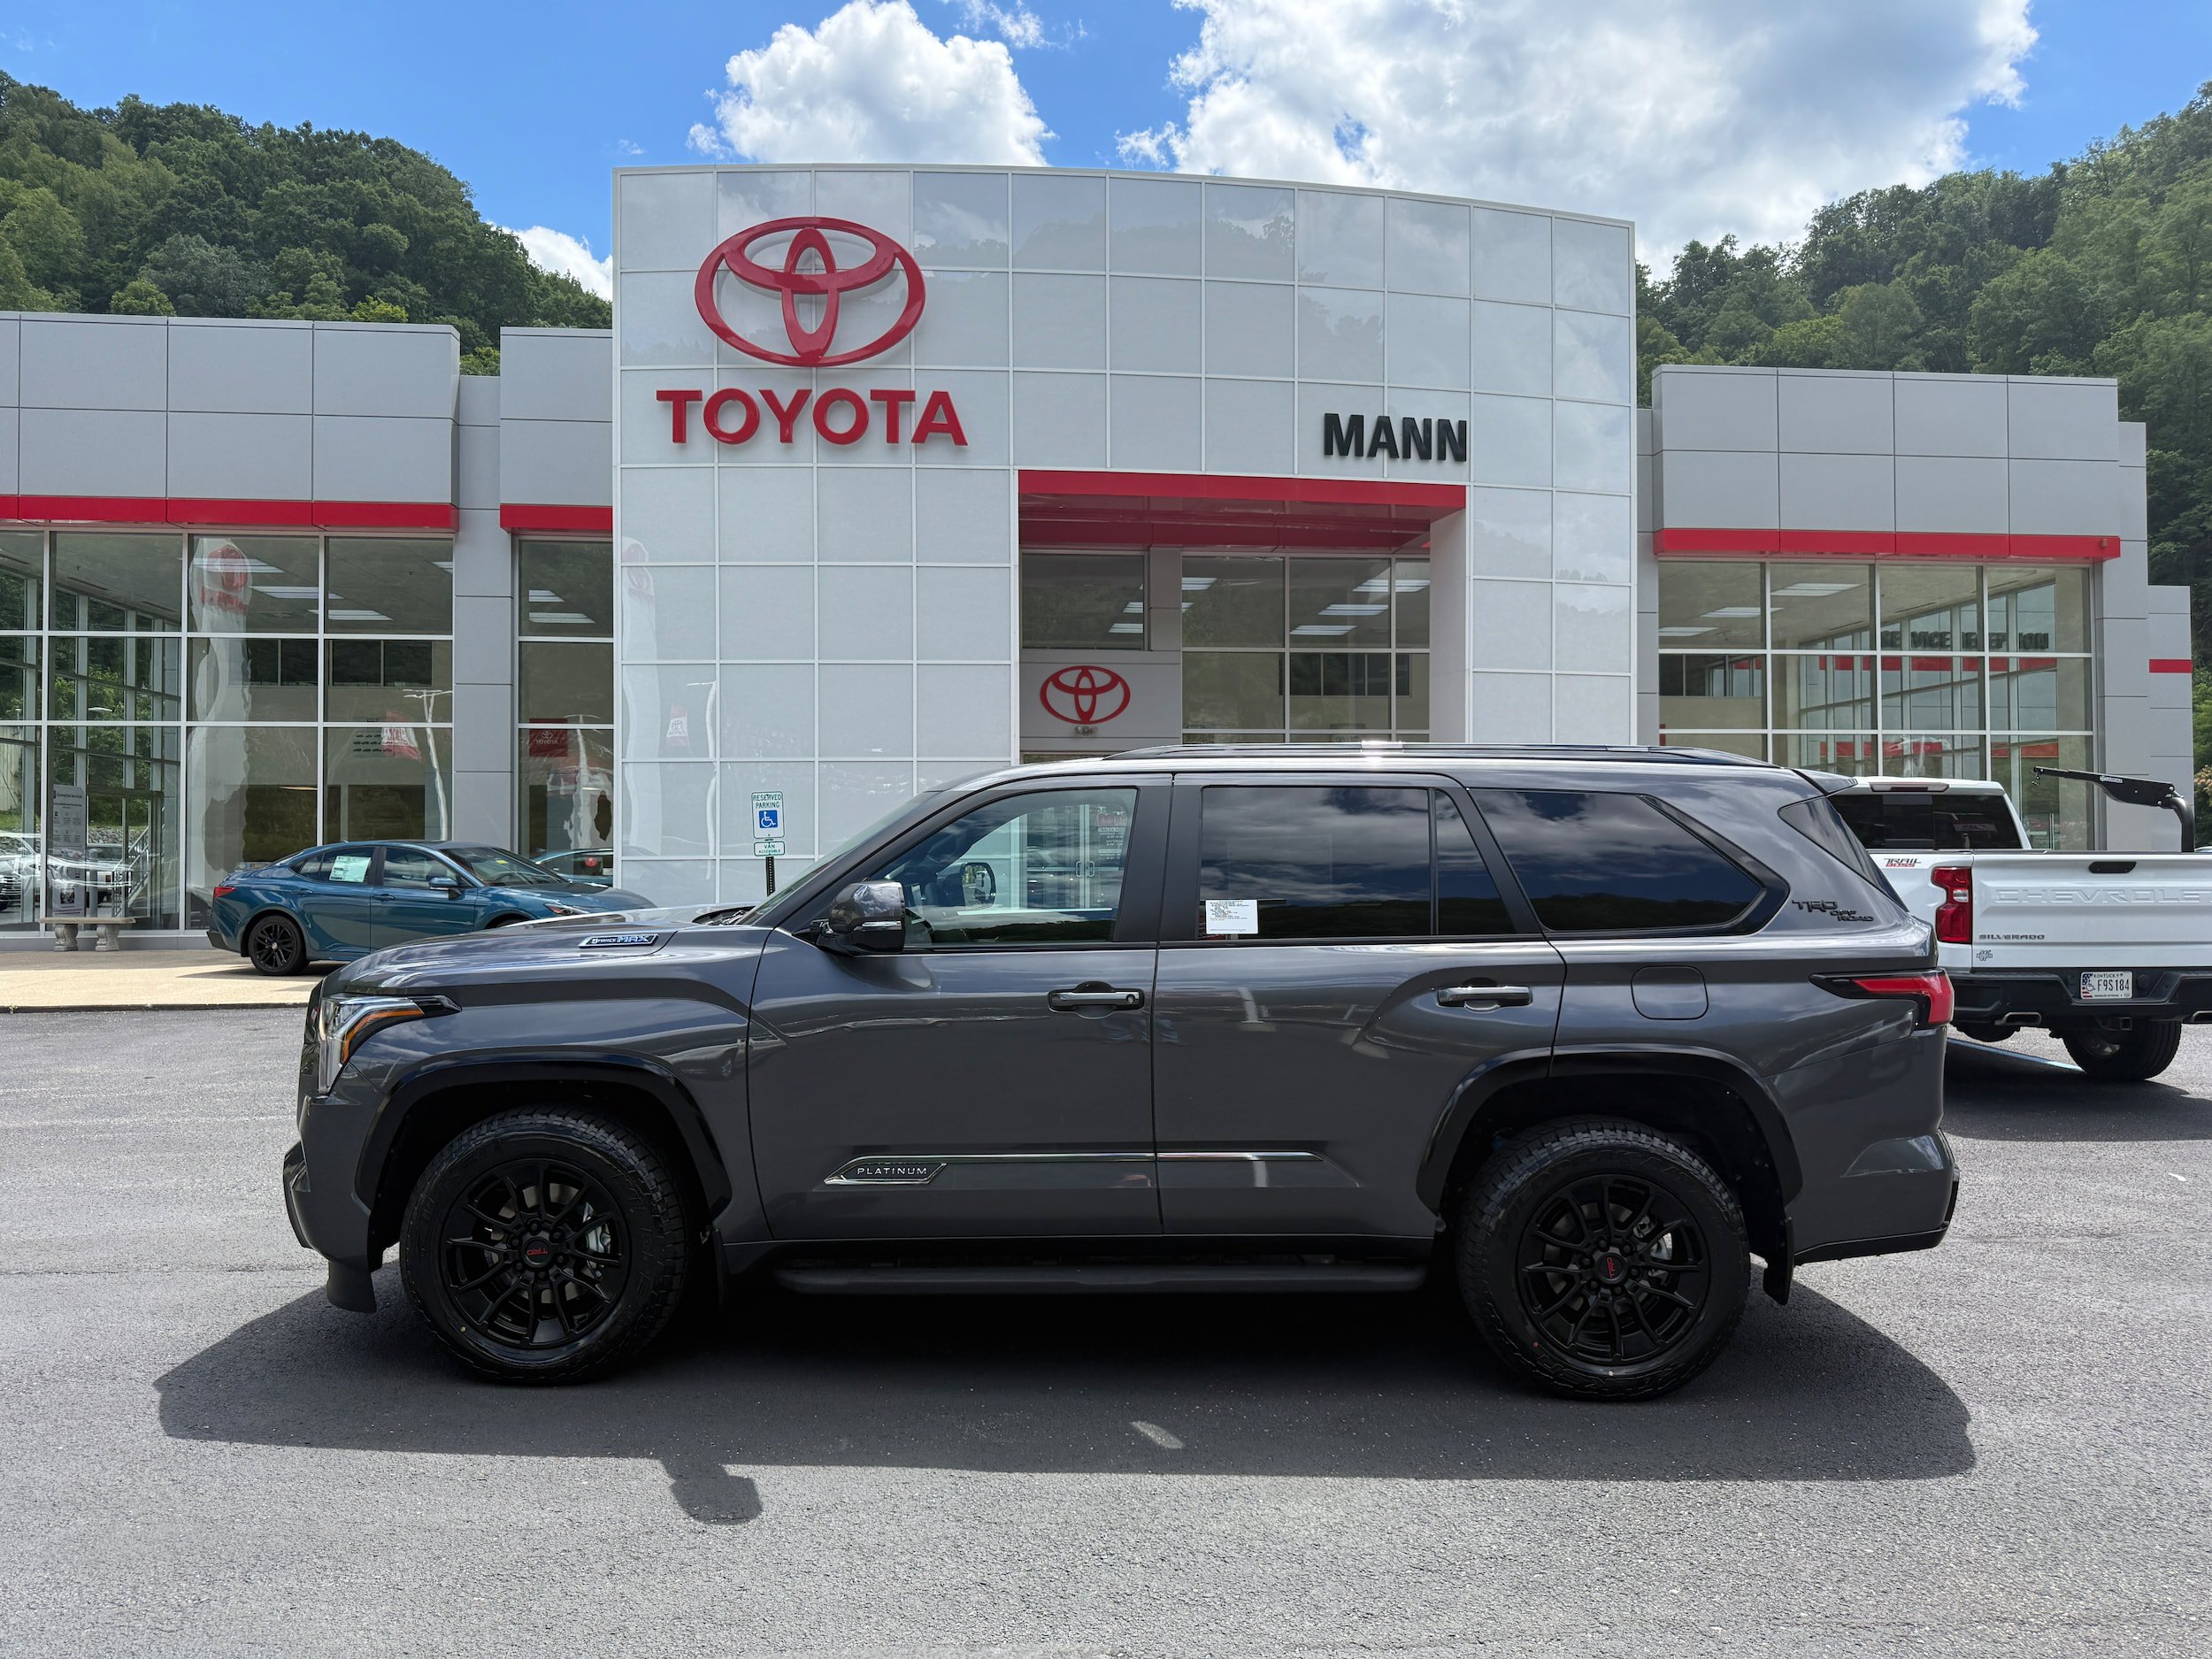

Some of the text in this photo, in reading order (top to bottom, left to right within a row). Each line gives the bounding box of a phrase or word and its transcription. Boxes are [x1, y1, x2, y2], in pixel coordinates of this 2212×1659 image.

[657, 388, 968, 446] TOYOTA
[1324, 412, 1467, 462] MANN
[1994, 888, 2212, 903] CHEVROLE
[1792, 899, 1838, 913] TRD
[617, 935, 649, 944] MAX
[2097, 979, 2130, 992] F9S184
[856, 1167, 927, 1176] PLATINUM
